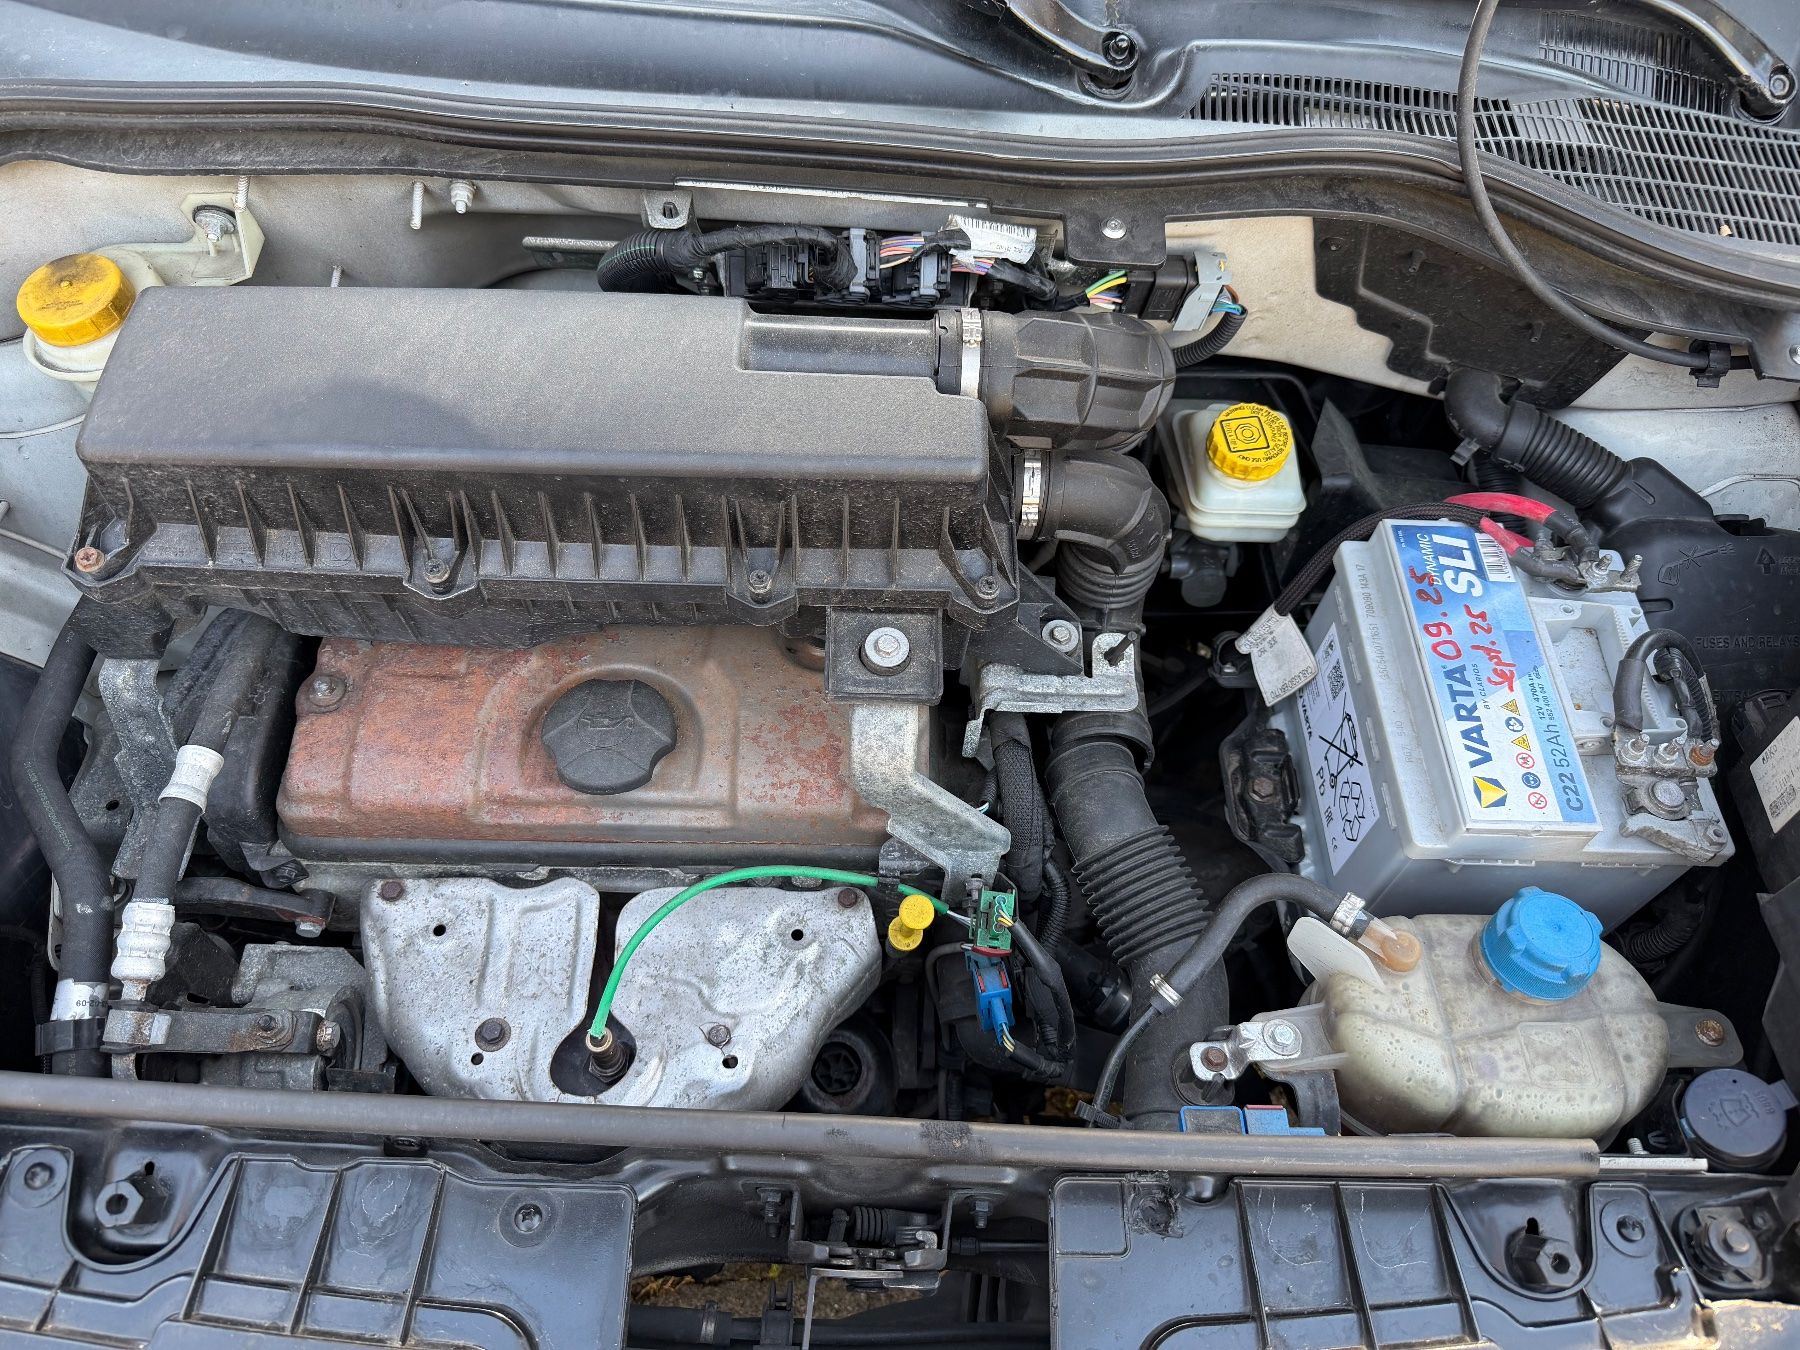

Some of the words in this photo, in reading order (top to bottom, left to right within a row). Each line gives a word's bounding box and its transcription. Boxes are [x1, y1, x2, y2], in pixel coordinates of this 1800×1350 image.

[1416, 533, 1443, 586] DYNAMIC
[1431, 533, 1484, 598] SLI
[1463, 604, 1494, 635] 25
[1696, 636, 1729, 649] FUSES
[1734, 636, 1755, 649] AND
[1472, 664, 1487, 697] CLARIOS
[1443, 664, 1493, 768] VARTA
[1481, 699, 1491, 710] BY
[1536, 706, 1546, 720] 12V
[1543, 724, 1571, 768] 52Ah
[1316, 766, 1326, 797] Pb
[1558, 772, 1584, 811] C22
